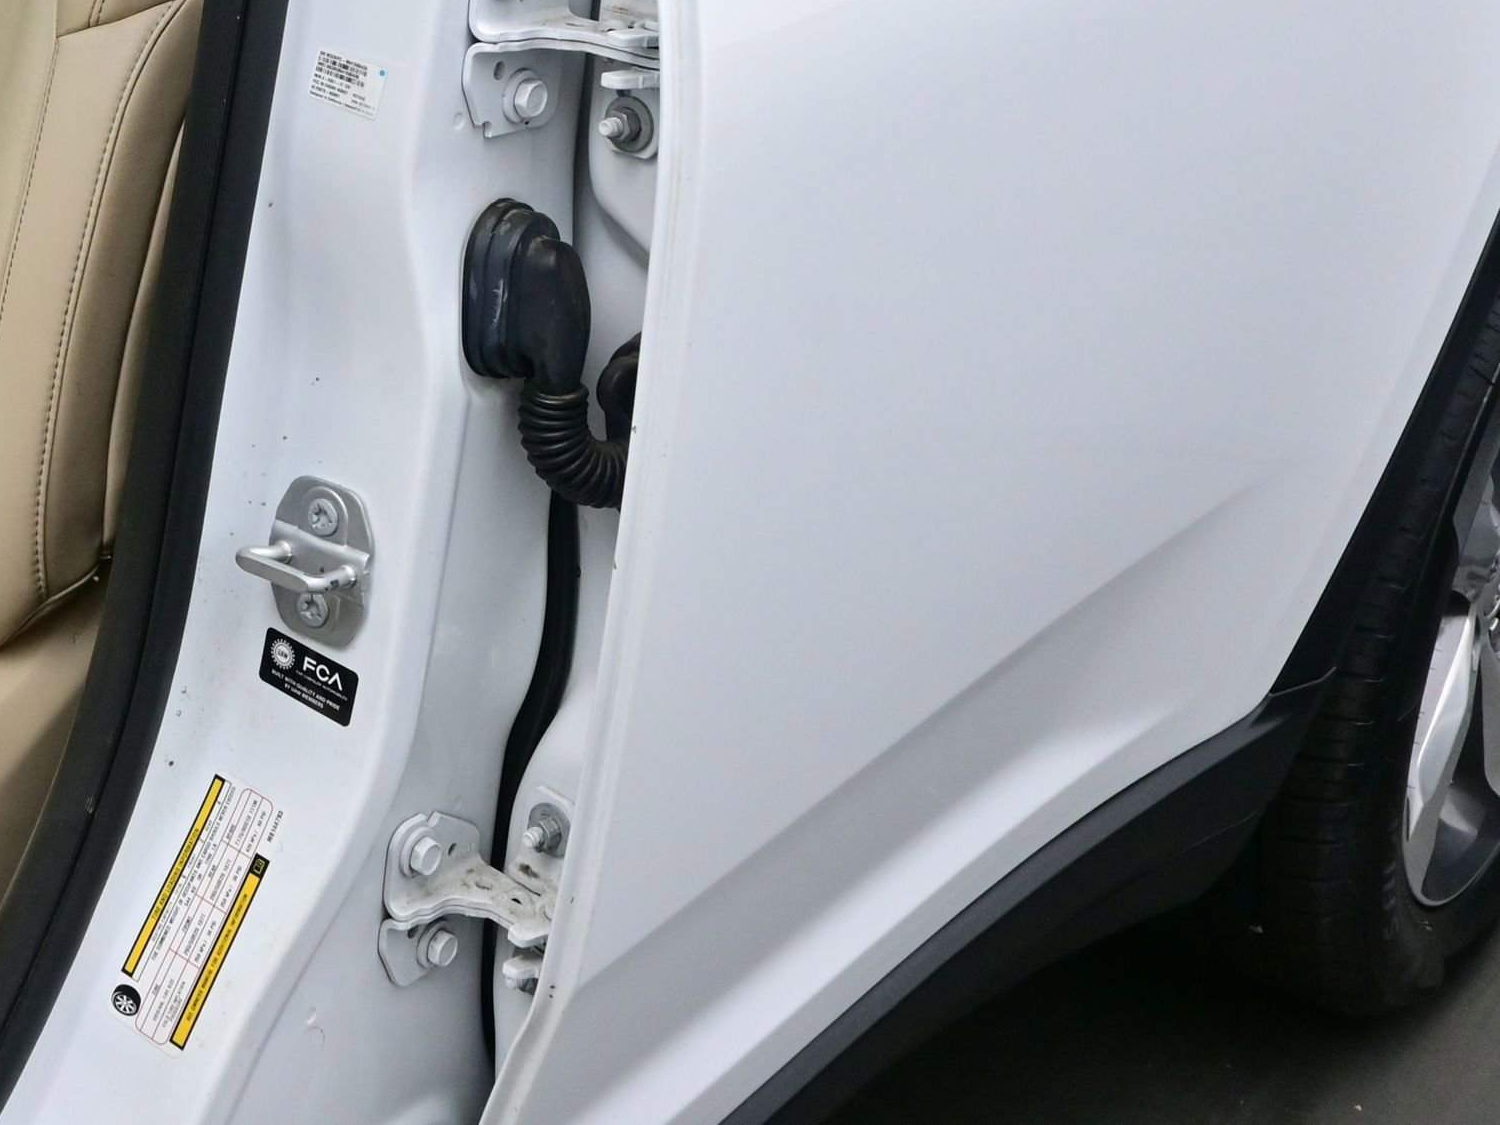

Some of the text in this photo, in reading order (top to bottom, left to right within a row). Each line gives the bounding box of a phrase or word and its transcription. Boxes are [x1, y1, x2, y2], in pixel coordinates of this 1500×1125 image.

[271, 668, 340, 710] BUILT WITH QUALITY AND PRIDE
[302, 654, 344, 692] FCA
[284, 682, 324, 709] BY UAW MEMBERS
[151, 827, 199, 920] TIRE AND LOADING INFORMATION
